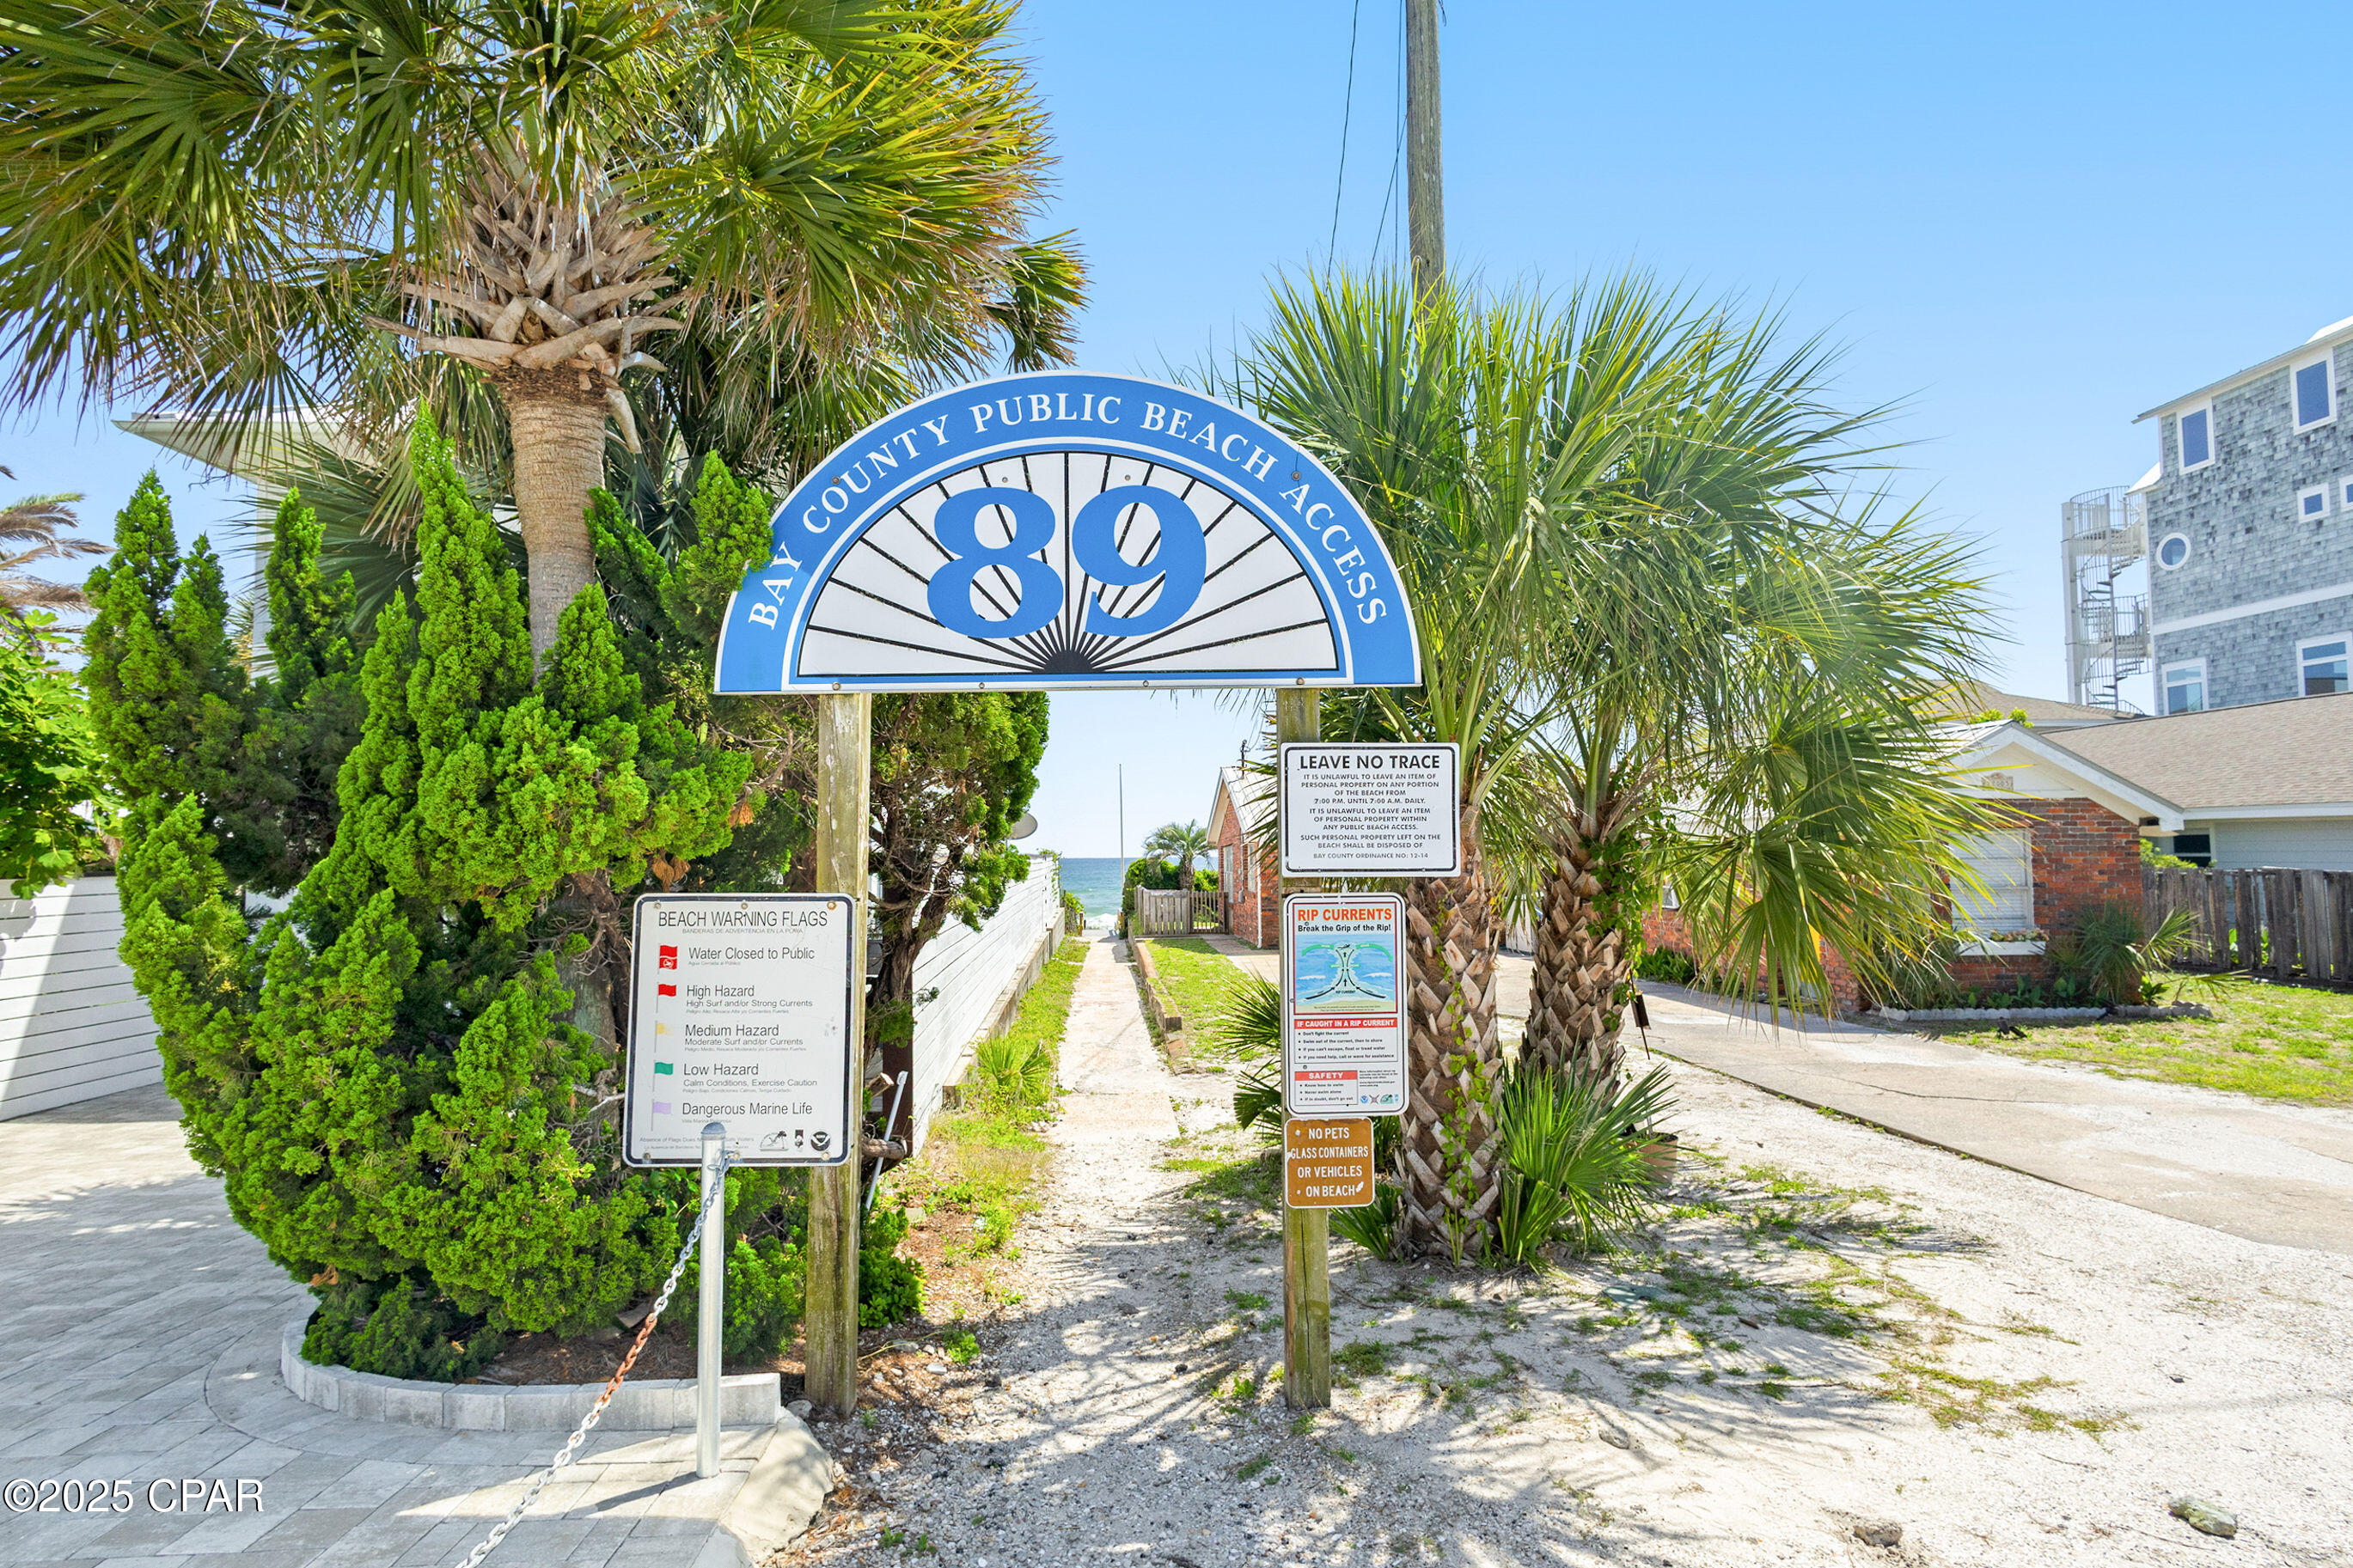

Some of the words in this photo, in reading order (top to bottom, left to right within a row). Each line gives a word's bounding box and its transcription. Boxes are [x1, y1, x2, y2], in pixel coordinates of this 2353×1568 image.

[748, 540, 804, 631] BAY
[803, 414, 950, 534] COUNTY
[968, 393, 1122, 434] PUBLIC
[1140, 401, 1280, 483] BEACH
[1279, 483, 1388, 625] ACCESS
[927, 485, 1207, 638] 89
[1300, 756, 1350, 769] LEAVE
[1357, 756, 1384, 769] NO
[1389, 756, 1439, 769] TRACE
[658, 911, 706, 926] BEACH
[712, 911, 777, 926] WARNING
[782, 911, 828, 926] FLAGS
[1298, 909, 1318, 921] RIP
[1323, 908, 1392, 921] CURRENTS
[1335, 924, 1351, 933] Grip
[1377, 924, 1391, 932] Rip!
[688, 948, 722, 959] Water
[725, 948, 764, 959] Closed
[767, 948, 779, 959] to
[782, 948, 816, 959] Public
[687, 985, 711, 1000] High
[715, 985, 755, 997] Hazard
[686, 999, 704, 1008] High
[751, 999, 777, 1009] Strong
[685, 1024, 730, 1036] Medium
[736, 1024, 779, 1036] Hazard
[683, 1064, 709, 1076] Low
[714, 1064, 759, 1076] Hazard
[706, 1079, 749, 1088] Conditions,
[682, 1102, 746, 1118] Dangerous
[749, 1102, 788, 1114] Marine
[792, 1102, 813, 1114] Life
[1308, 1128, 1323, 1139] NO
[1324, 1127, 1350, 1139] PETS
[1291, 1147, 1317, 1159] GLASS
[1318, 1146, 1369, 1158] CONTAINERS
[1298, 1167, 1311, 1178] OR
[1314, 1165, 1363, 1178] VEHICLES
[1306, 1186, 1320, 1197] ON
[1322, 1185, 1355, 1197] BEACH
